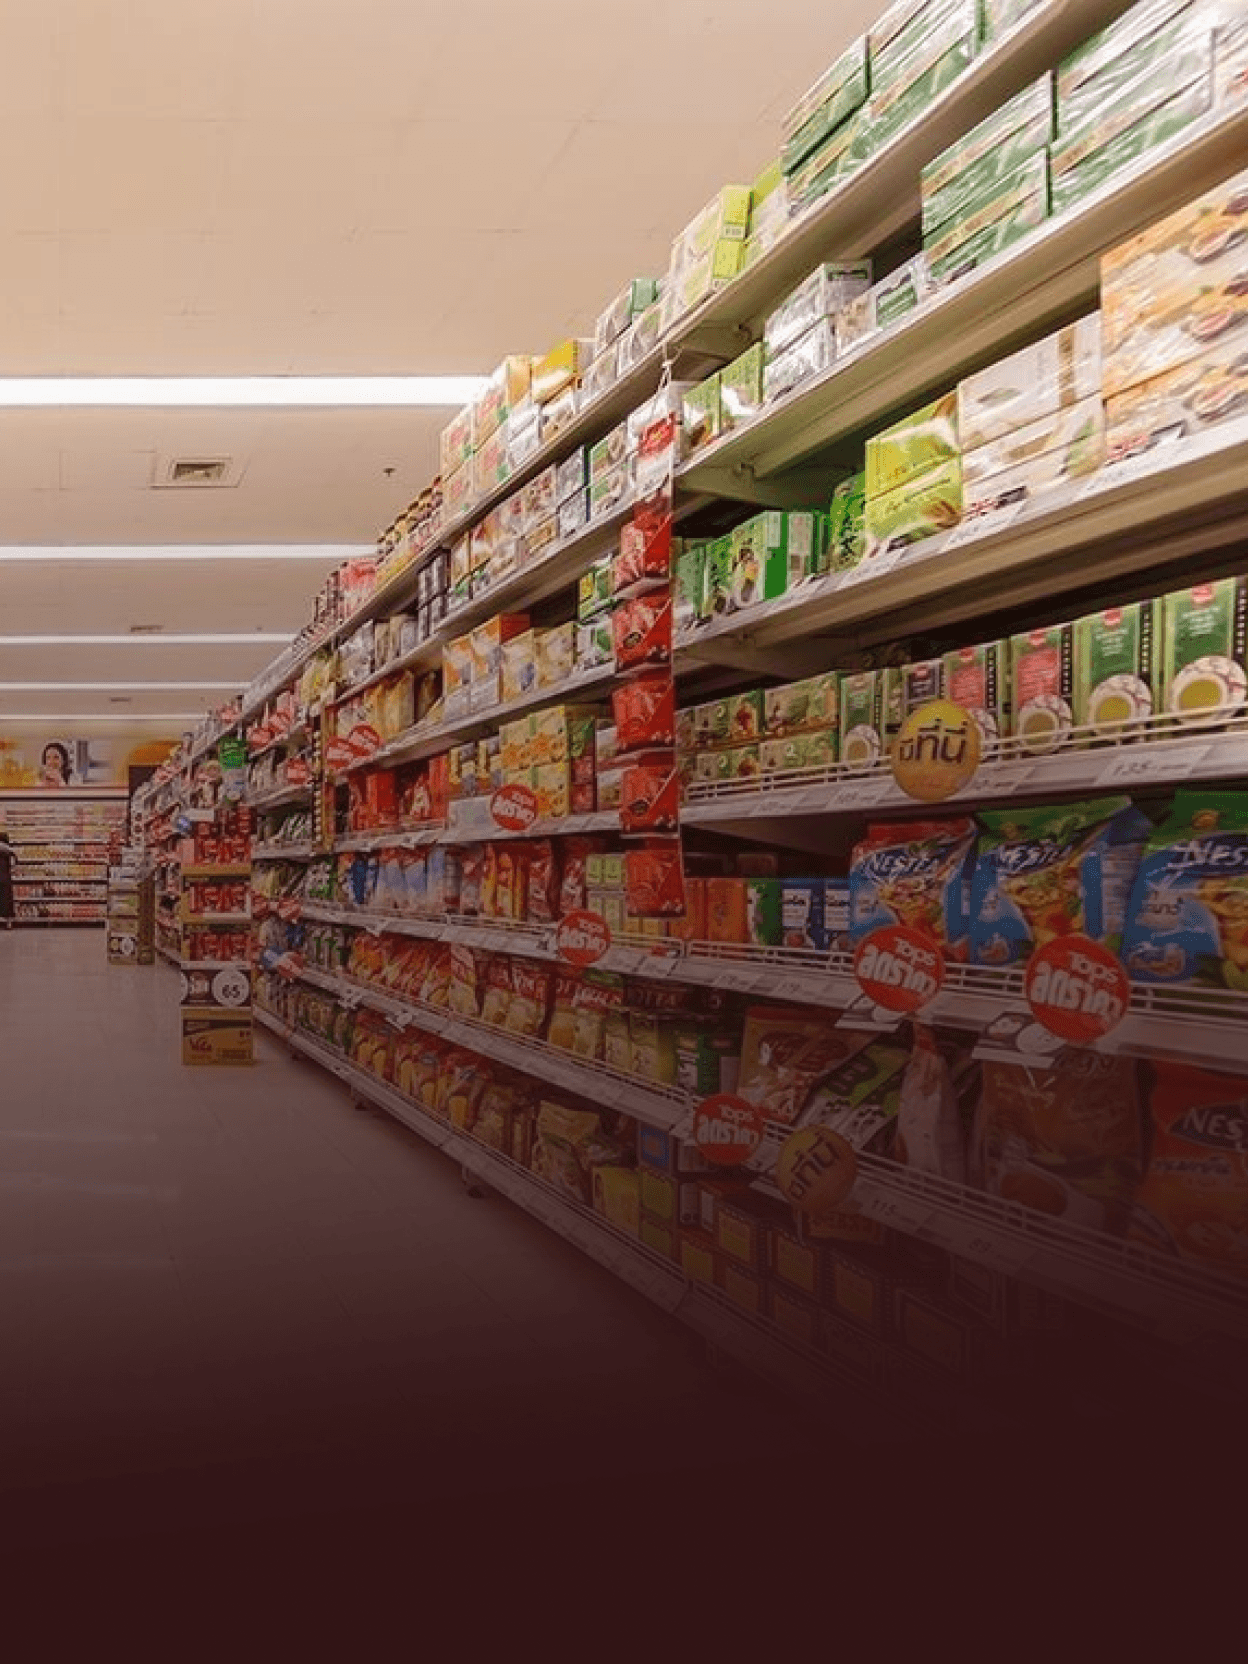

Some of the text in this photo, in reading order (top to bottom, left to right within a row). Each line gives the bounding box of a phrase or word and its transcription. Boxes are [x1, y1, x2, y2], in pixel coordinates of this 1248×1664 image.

[1174, 840, 1248, 866] NES
[1069, 951, 1120, 984] Tops
[221, 984, 241, 998] 65
